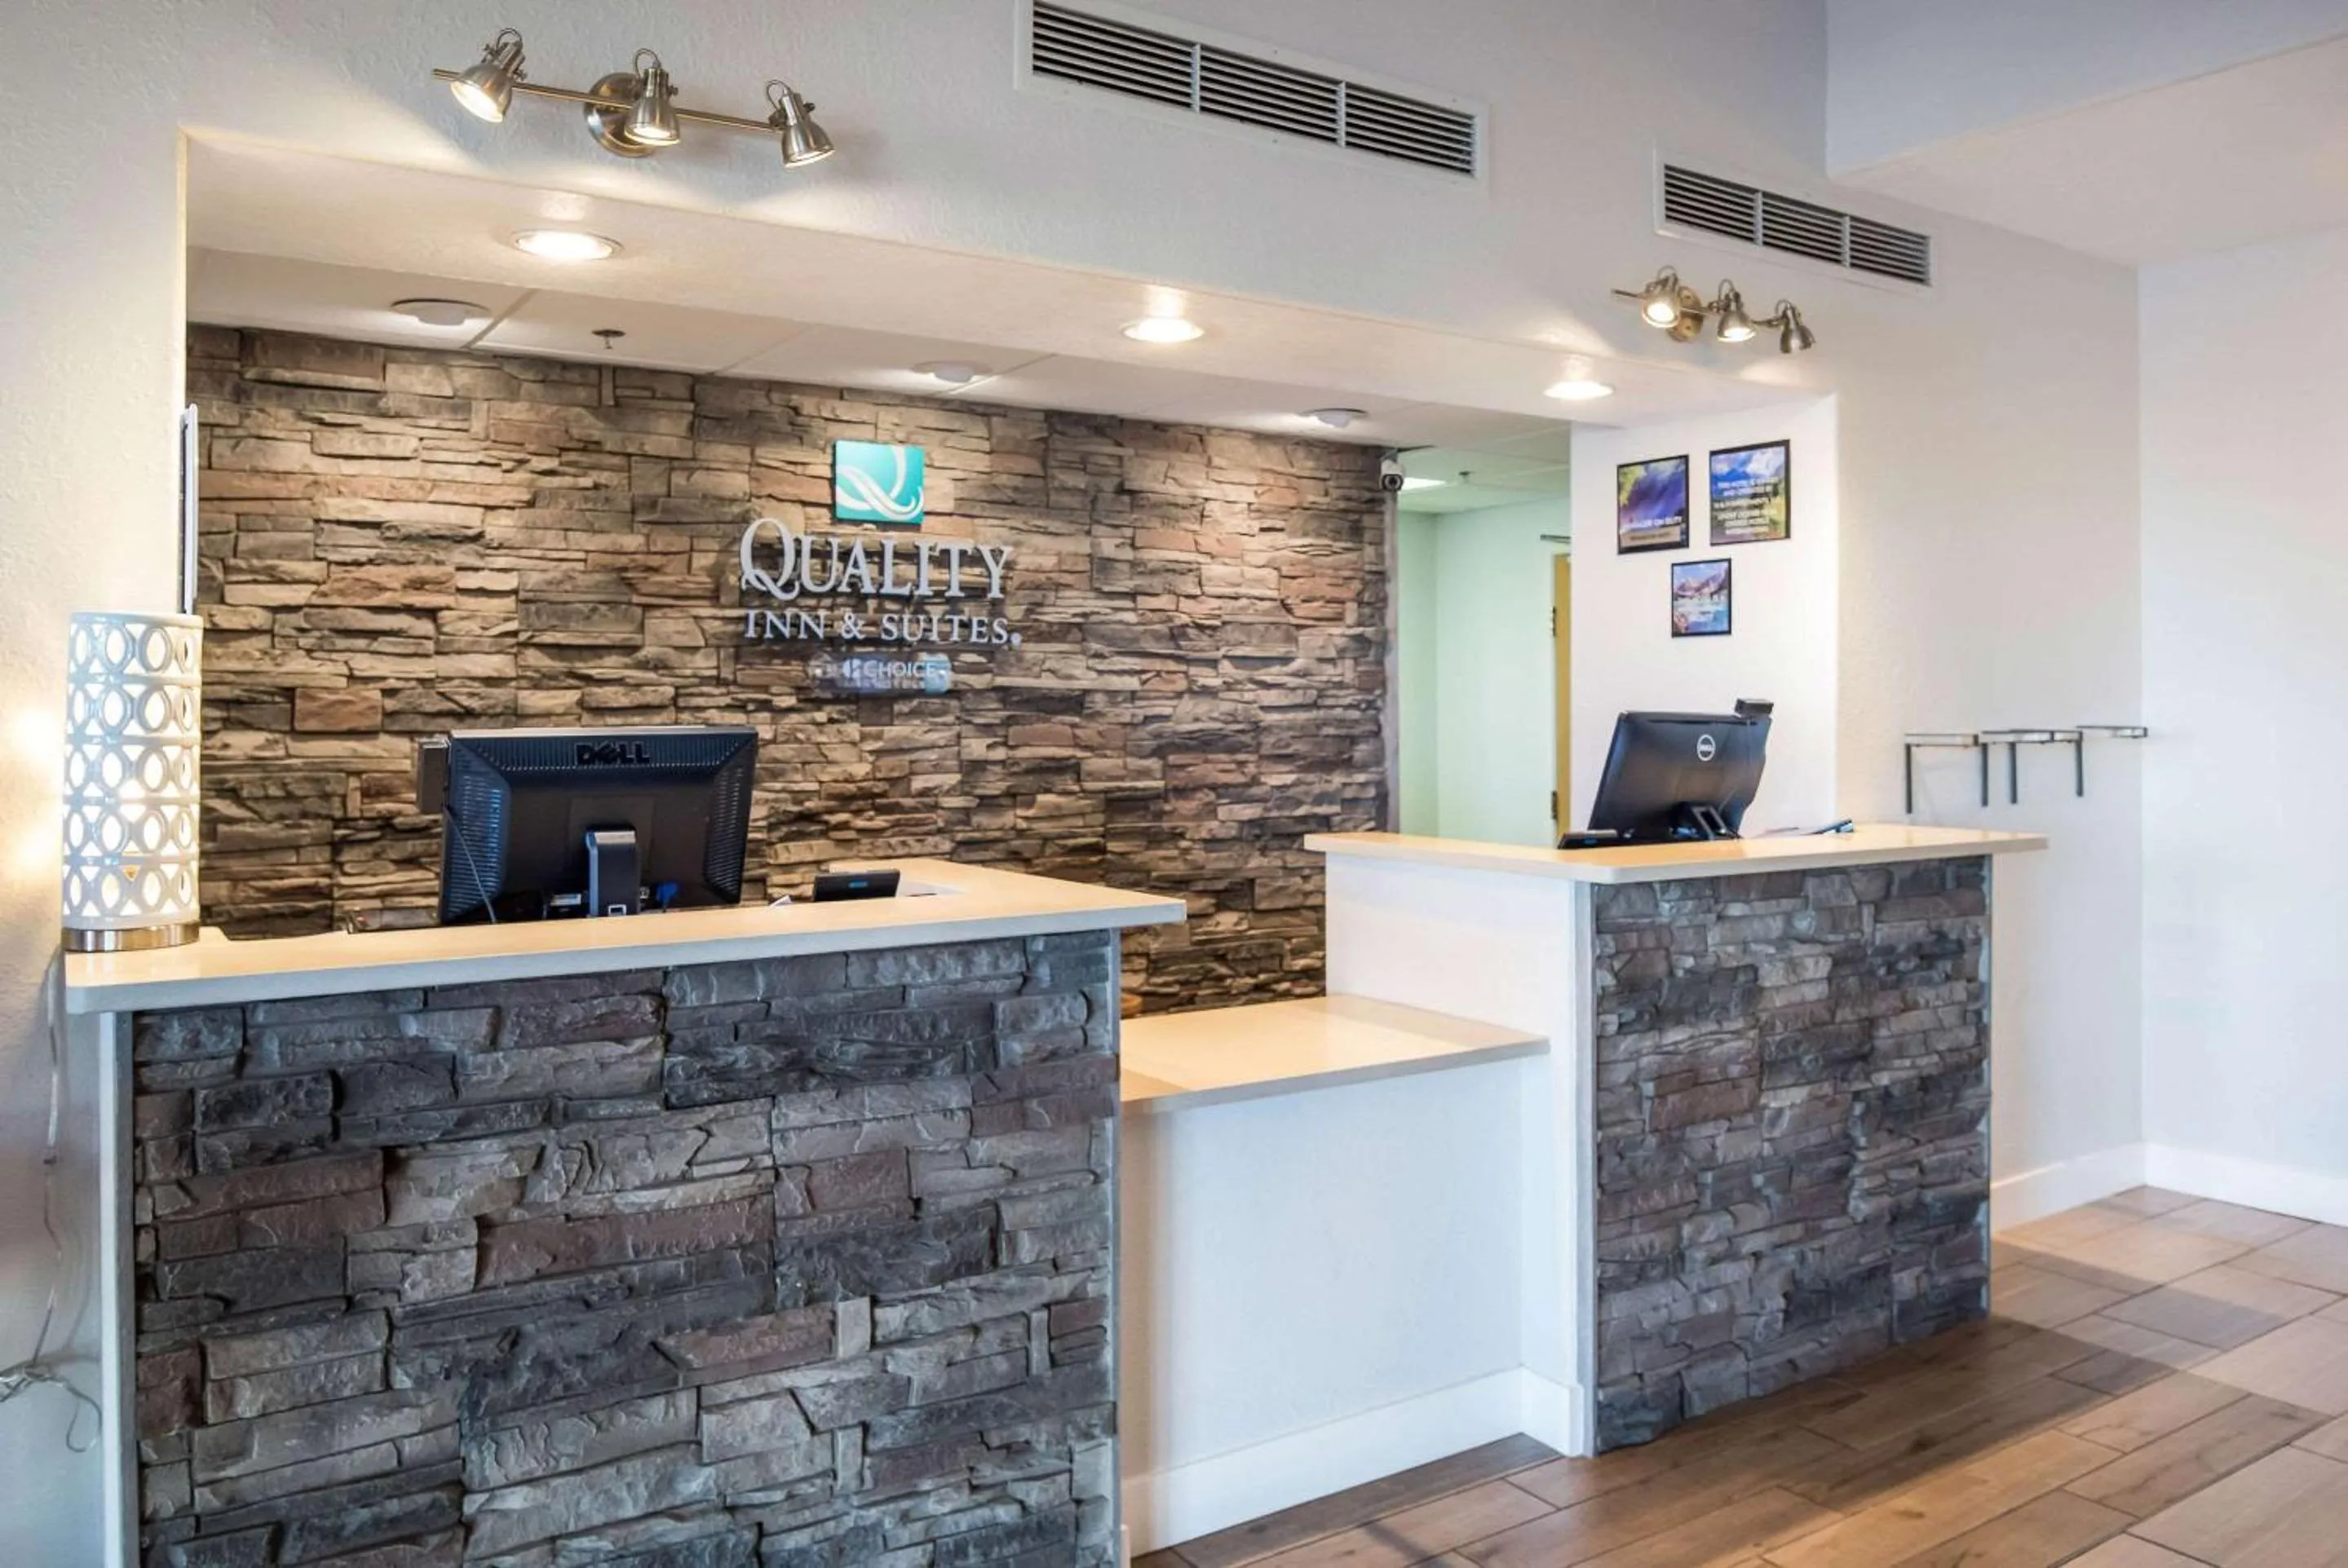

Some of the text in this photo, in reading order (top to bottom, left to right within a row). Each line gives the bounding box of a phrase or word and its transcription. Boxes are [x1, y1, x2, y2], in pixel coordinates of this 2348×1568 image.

[740, 518, 1013, 601] QUALITY
[745, 609, 827, 639] INN
[841, 612, 866, 639] &
[863, 659, 935, 678] CHOICE
